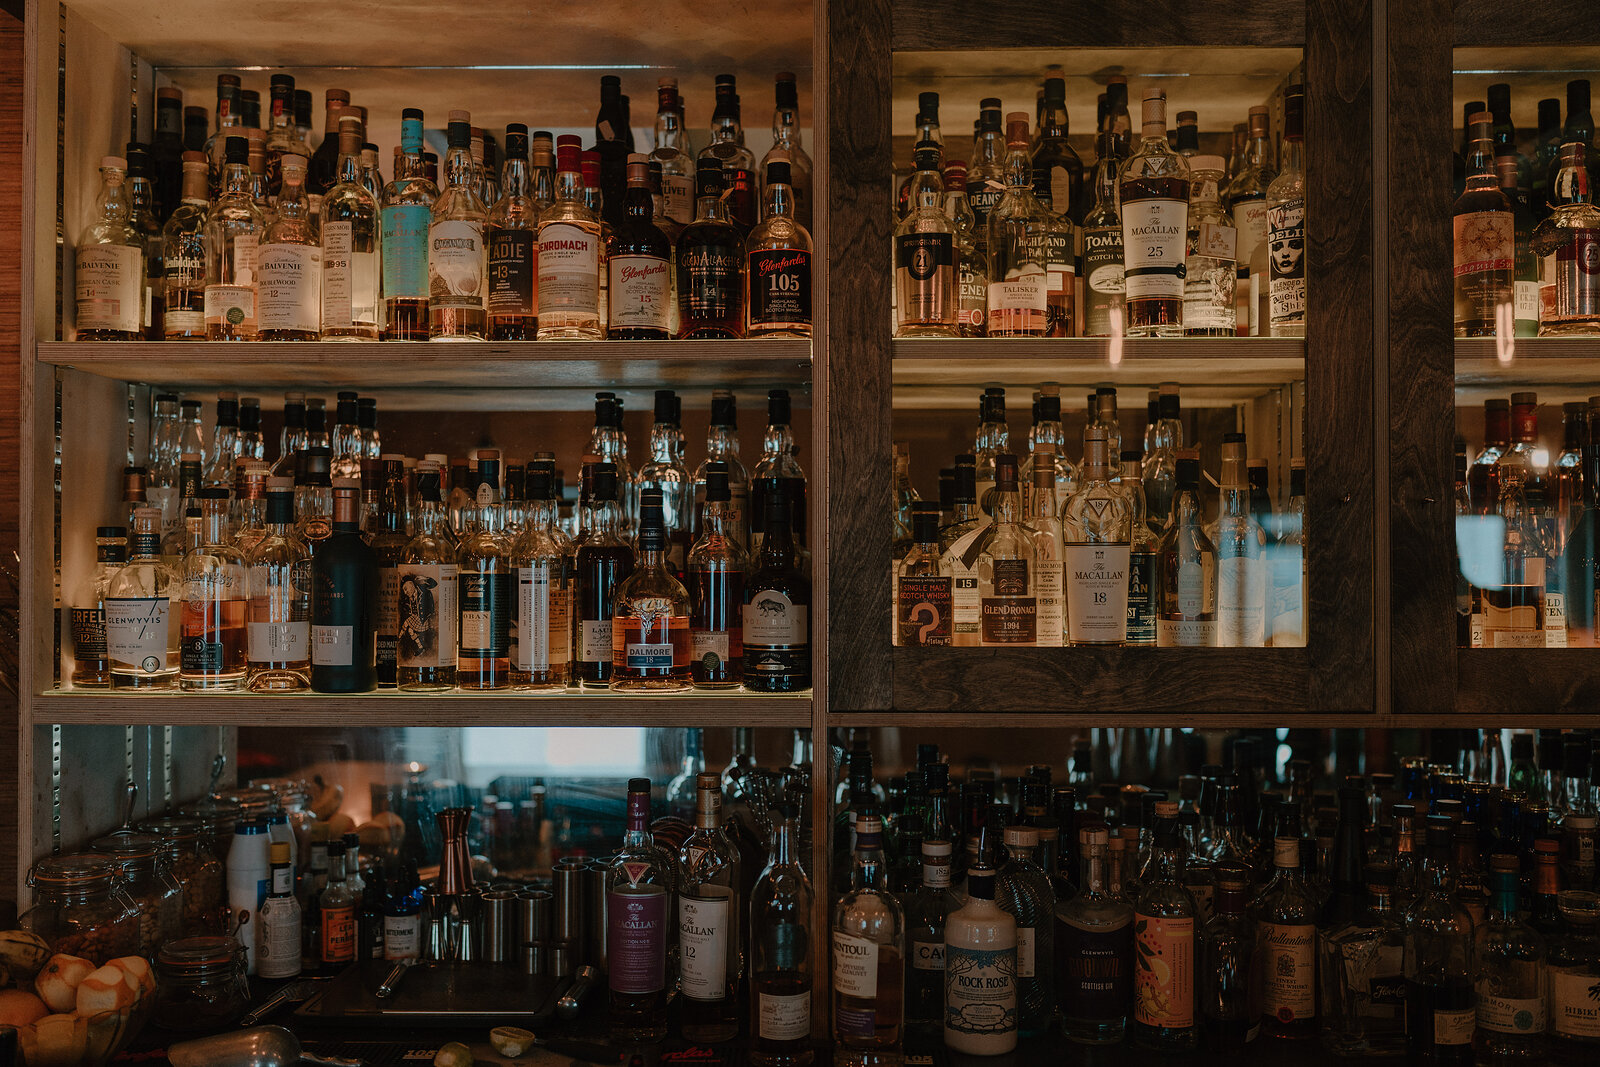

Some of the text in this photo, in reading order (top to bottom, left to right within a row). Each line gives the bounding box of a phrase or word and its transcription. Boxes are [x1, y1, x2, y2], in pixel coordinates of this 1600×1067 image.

[664, 186, 688, 197] LIVET
[664, 196, 671, 206] 5
[970, 193, 1000, 208] DEANS
[1131, 226, 1180, 236] MACALLAN
[1085, 235, 1123, 252] TOMA
[1147, 246, 1163, 257] 25
[1586, 248, 1599, 262] 25
[916, 254, 928, 268] 21
[1087, 253, 1114, 262] SCOTCH
[82, 262, 121, 270] BALVENIE
[328, 260, 347, 268] 1995
[758, 252, 806, 277] Glenfarclas
[497, 265, 509, 279] 13
[768, 273, 800, 292] 105
[960, 272, 974, 284] LD
[270, 289, 279, 298] 12
[704, 287, 717, 297] 14
[961, 284, 987, 297] ENEY
[1003, 286, 1039, 294] TALISKER
[639, 295, 652, 303] 15
[1074, 571, 1124, 580] MACALLAN
[903, 584, 946, 592] SINGLE MALT
[962, 579, 972, 588] 15
[1093, 592, 1107, 603] 18
[72, 610, 106, 623] ERFEL
[108, 616, 161, 624] GLENWYVIS
[1003, 622, 1020, 630] 1994
[1163, 624, 1215, 632] LAGAVULIN
[80, 633, 90, 643] 12
[194, 641, 202, 651] 8
[629, 648, 670, 656] DALMORE
[614, 920, 657, 929] MACALLAN
[680, 923, 714, 936] ACALLAN
[685, 945, 696, 958] 12
[958, 975, 1009, 989] ROCK ROSE
[1081, 982, 1103, 991] SCOTTISH
[1564, 1005, 1598, 1017] HIBIKI
